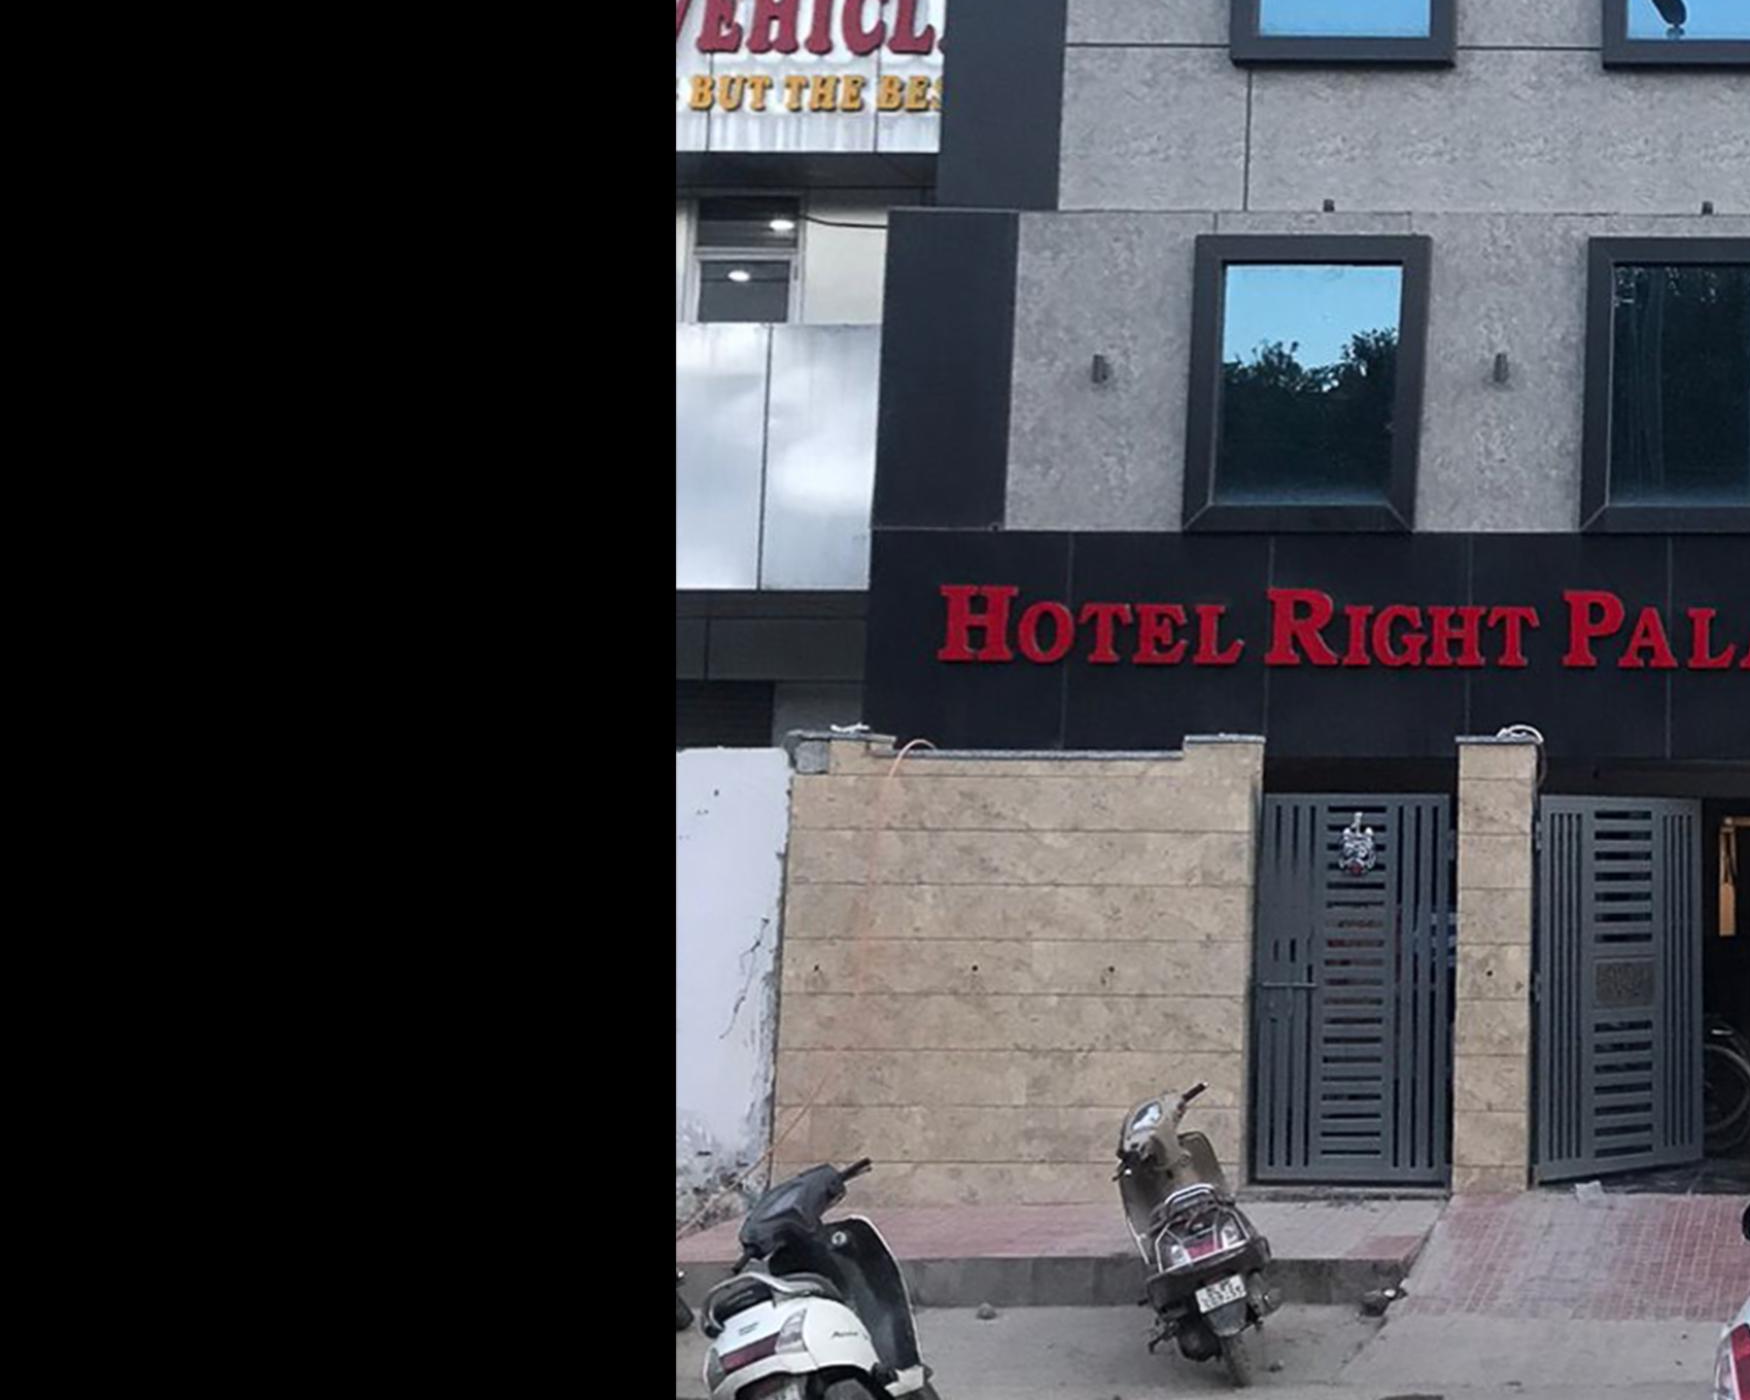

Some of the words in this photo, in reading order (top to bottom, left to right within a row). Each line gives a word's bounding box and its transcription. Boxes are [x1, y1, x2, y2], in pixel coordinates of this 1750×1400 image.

[690, 75, 773, 111] BUT
[785, 75, 866, 112] THE
[937, 585, 1245, 665] HOTEL
[1265, 588, 1541, 667] RIGHT
